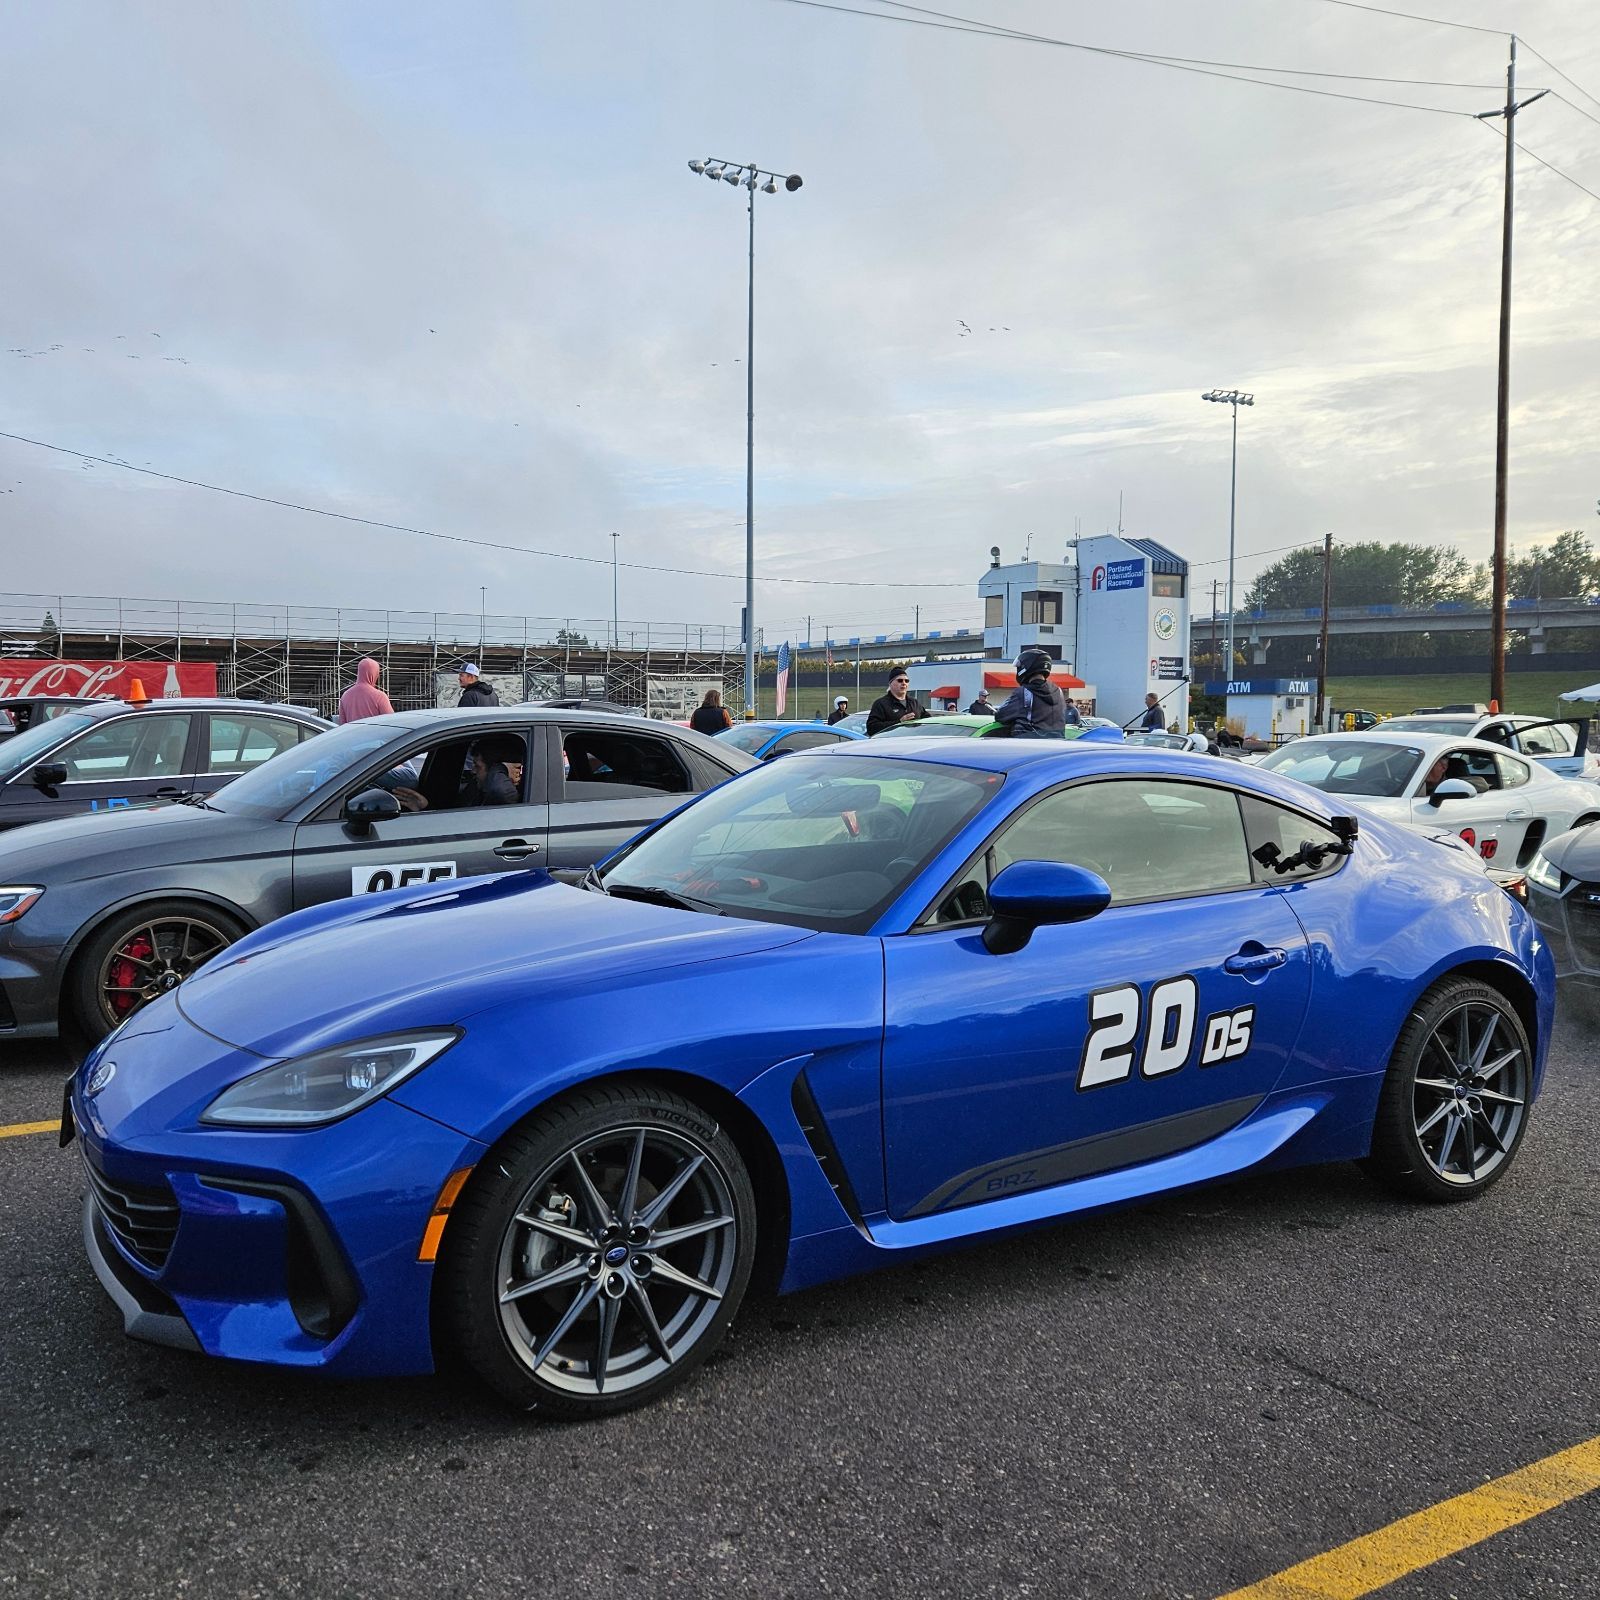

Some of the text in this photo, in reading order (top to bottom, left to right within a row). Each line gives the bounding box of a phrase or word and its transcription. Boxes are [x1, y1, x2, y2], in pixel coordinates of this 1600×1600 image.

[1107, 565, 1132, 574] Portland
[1107, 570, 1144, 580] International
[1107, 579, 1134, 587] Raceway
[1226, 681, 1251, 693] ATM
[1288, 681, 1309, 693] ATM
[1076, 974, 1256, 1093] 20 DS
[655, 1110, 712, 1140] MICHELIN
[987, 1169, 1037, 1192] BRZ
